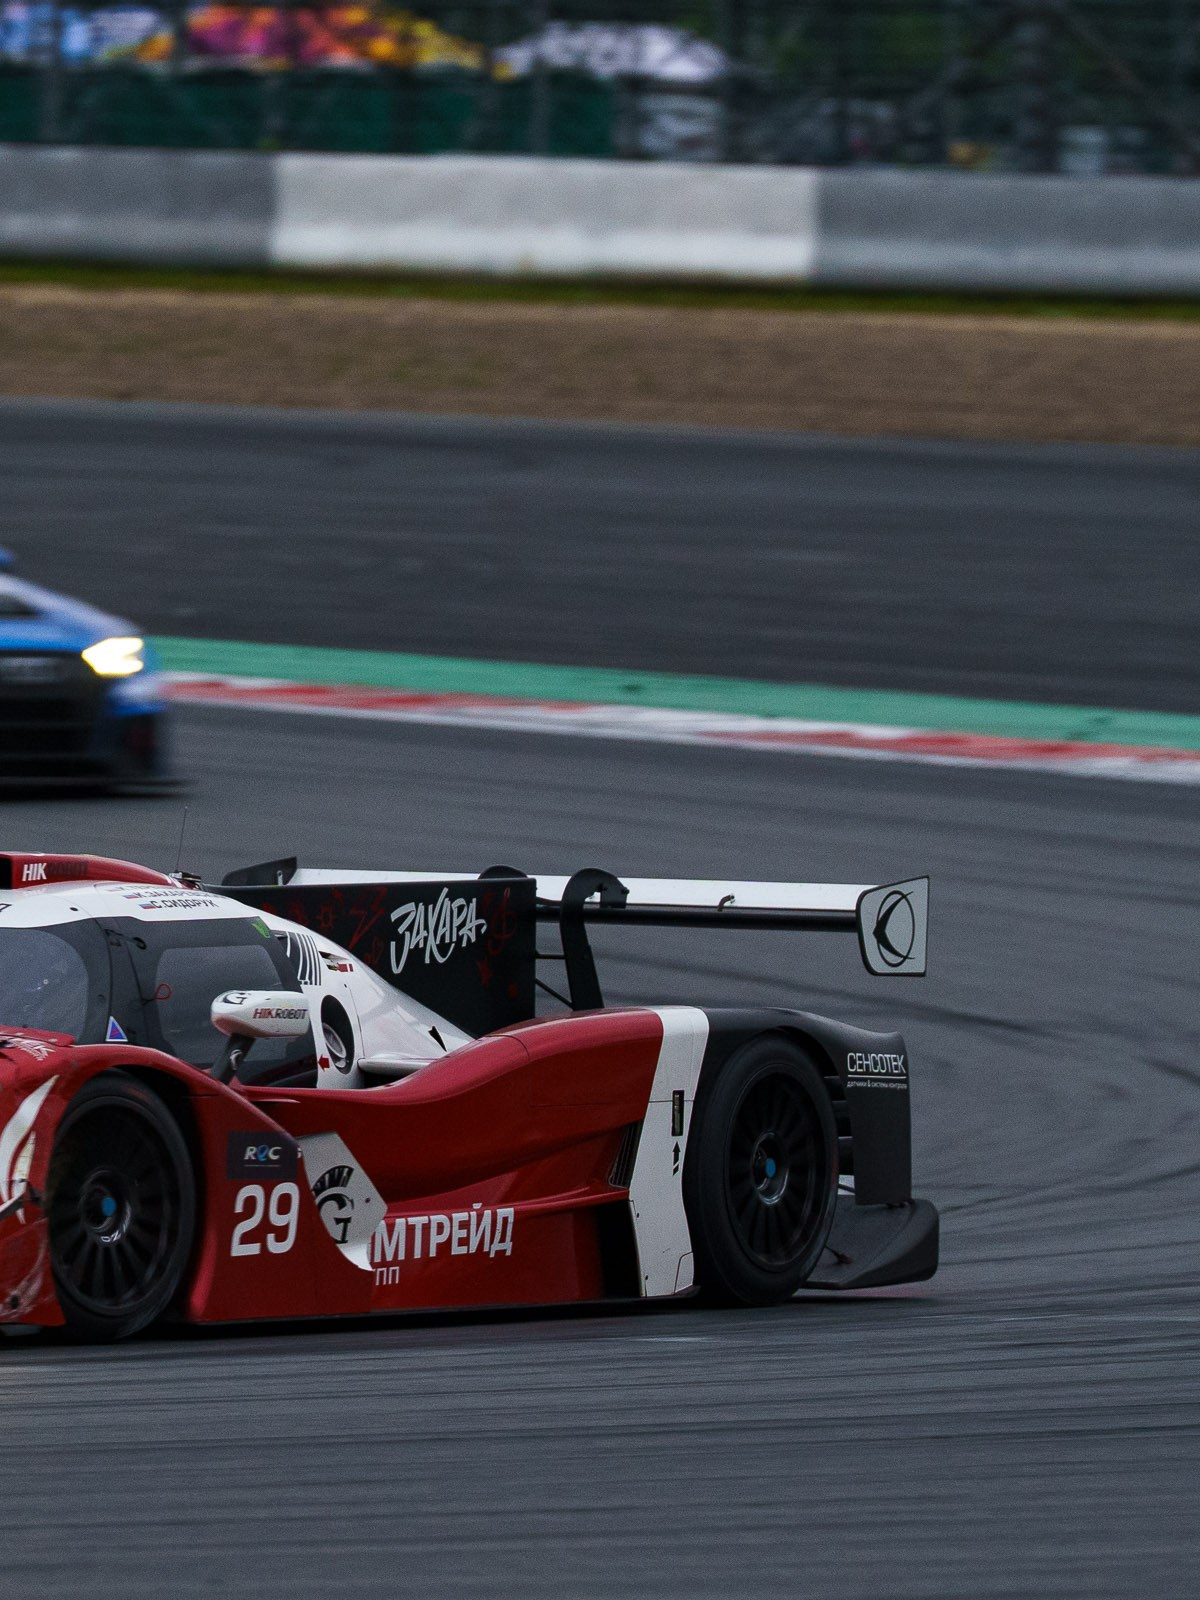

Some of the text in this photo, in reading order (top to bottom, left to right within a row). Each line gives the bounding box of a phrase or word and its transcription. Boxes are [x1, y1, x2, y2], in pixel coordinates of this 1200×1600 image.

[847, 1052, 906, 1074] СЕНСОТЕК
[230, 1181, 300, 1257] 29
[368, 1203, 514, 1263] МТРЕЙД
